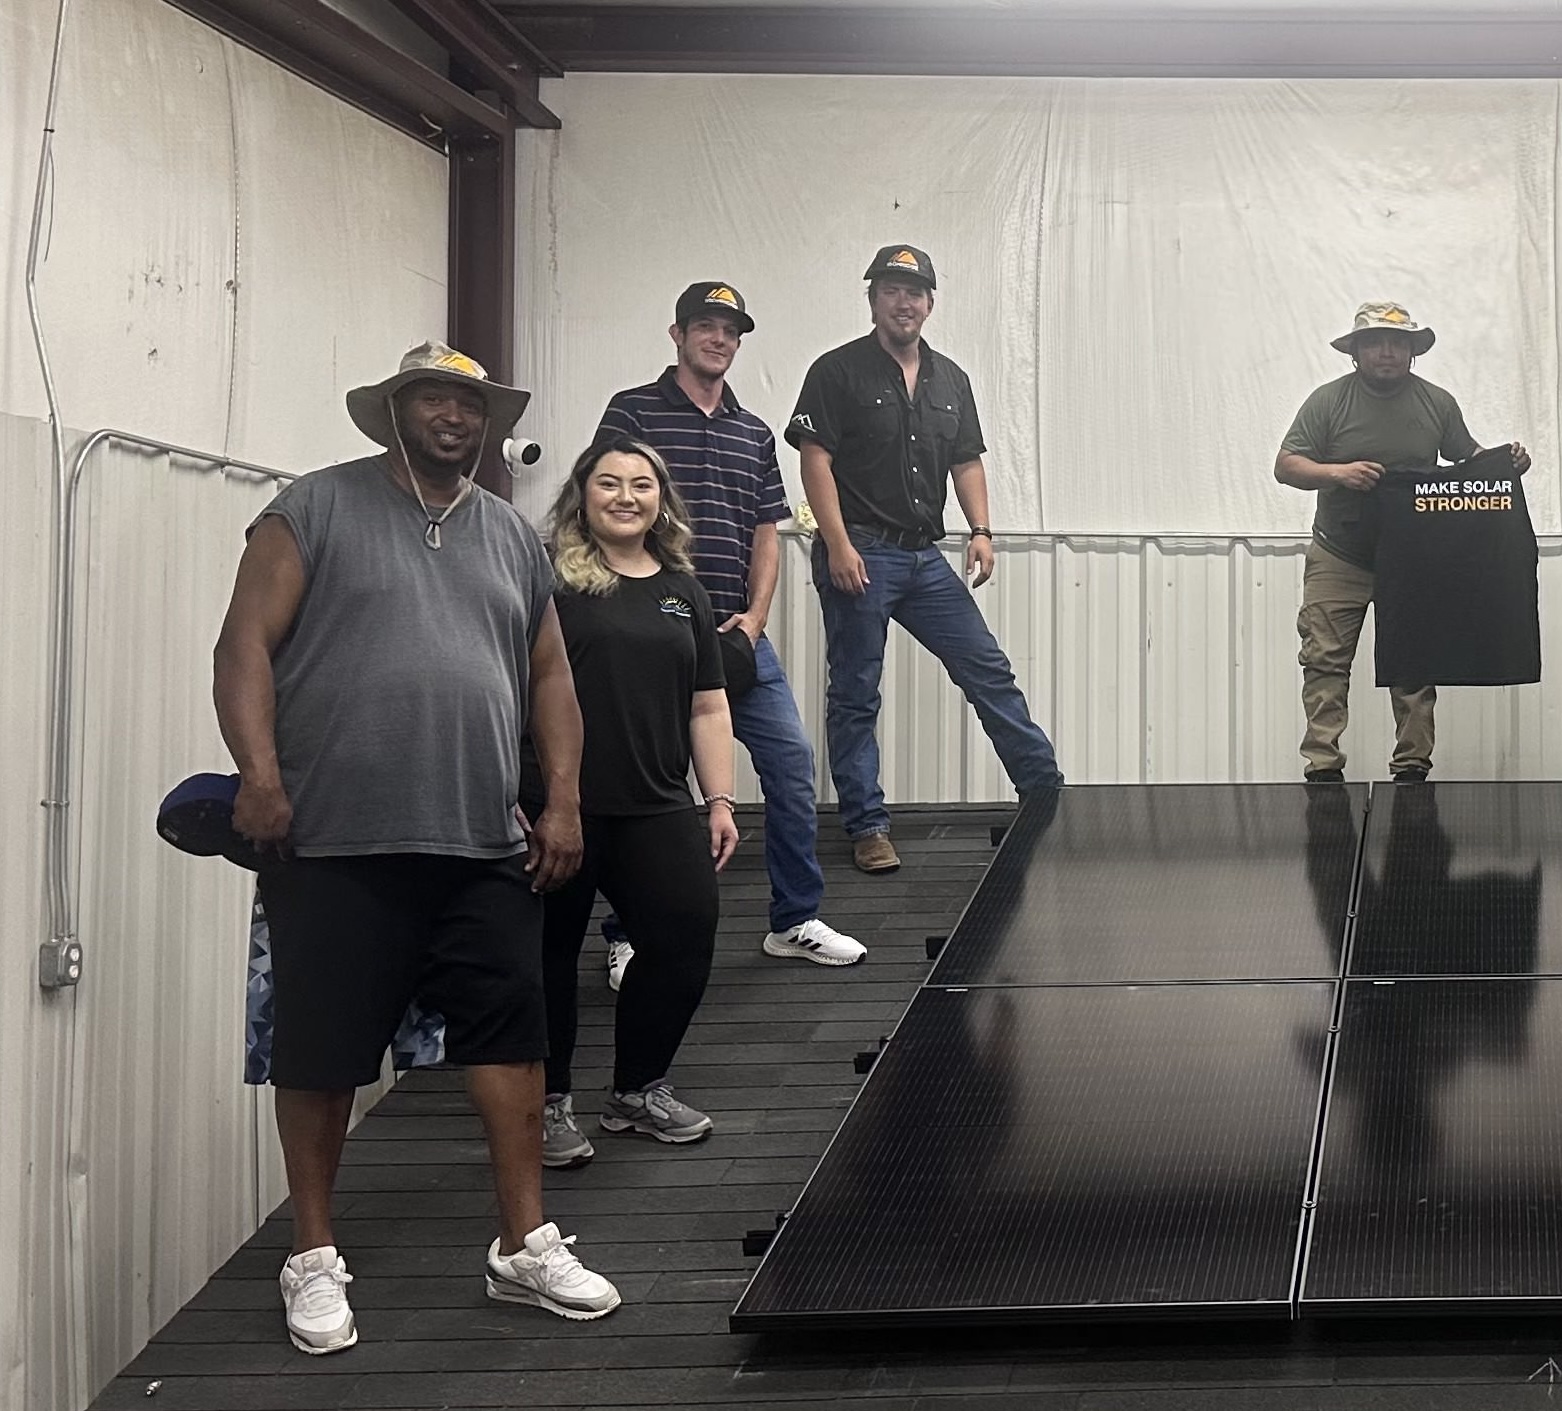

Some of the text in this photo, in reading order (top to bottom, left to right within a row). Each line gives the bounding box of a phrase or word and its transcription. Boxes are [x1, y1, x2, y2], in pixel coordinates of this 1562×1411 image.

[1415, 480, 1512, 495] MAKE SOLAR
[1415, 495, 1512, 512] STRONGER
